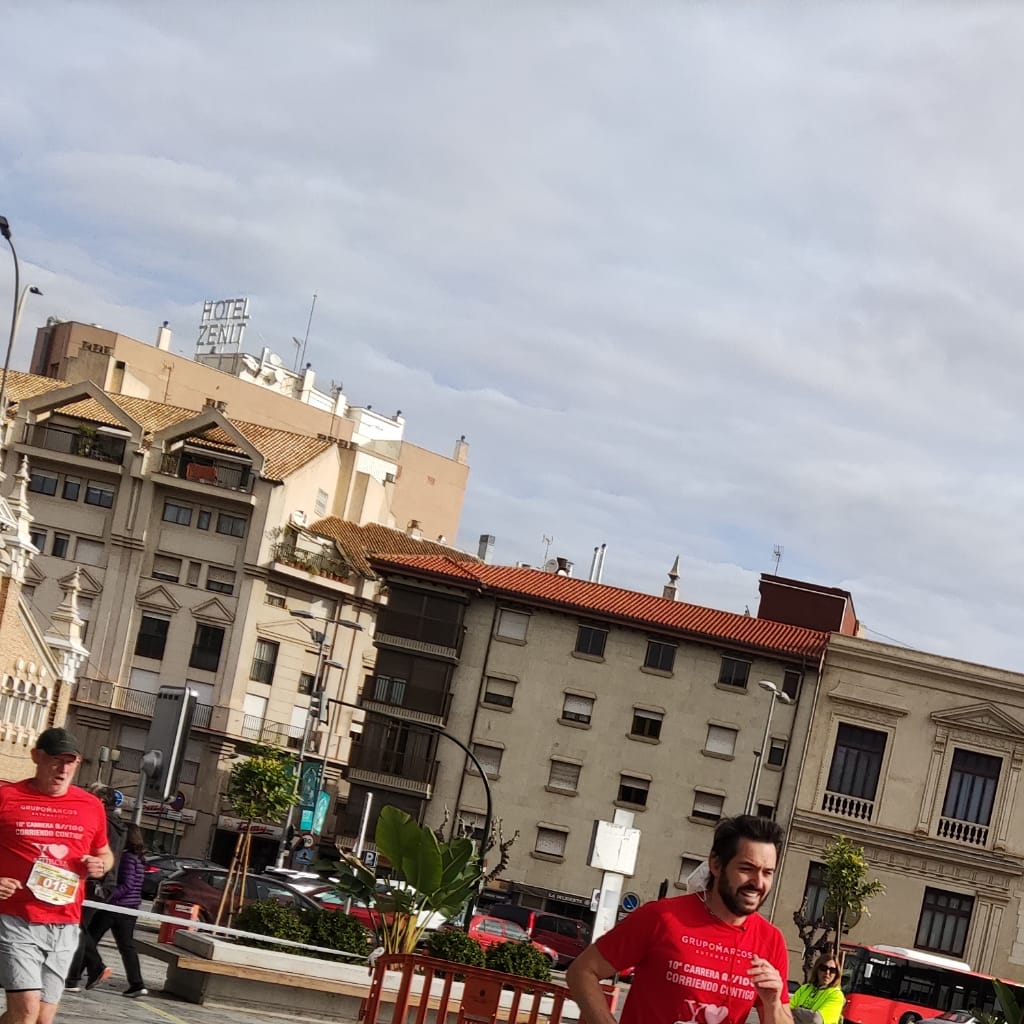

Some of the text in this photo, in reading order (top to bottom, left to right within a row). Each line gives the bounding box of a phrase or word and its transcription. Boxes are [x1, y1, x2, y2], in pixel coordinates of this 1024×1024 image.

[202, 298, 249, 320] HOTEL
[197, 323, 246, 345] ZENIT
[16, 828, 54, 836] CORRIENDO
[43, 878, 68, 892] 018
[681, 935, 753, 959] GRUPOMARCOS
[666, 971, 719, 993] CORRIENDO
[684, 963, 720, 980] CARRERA
